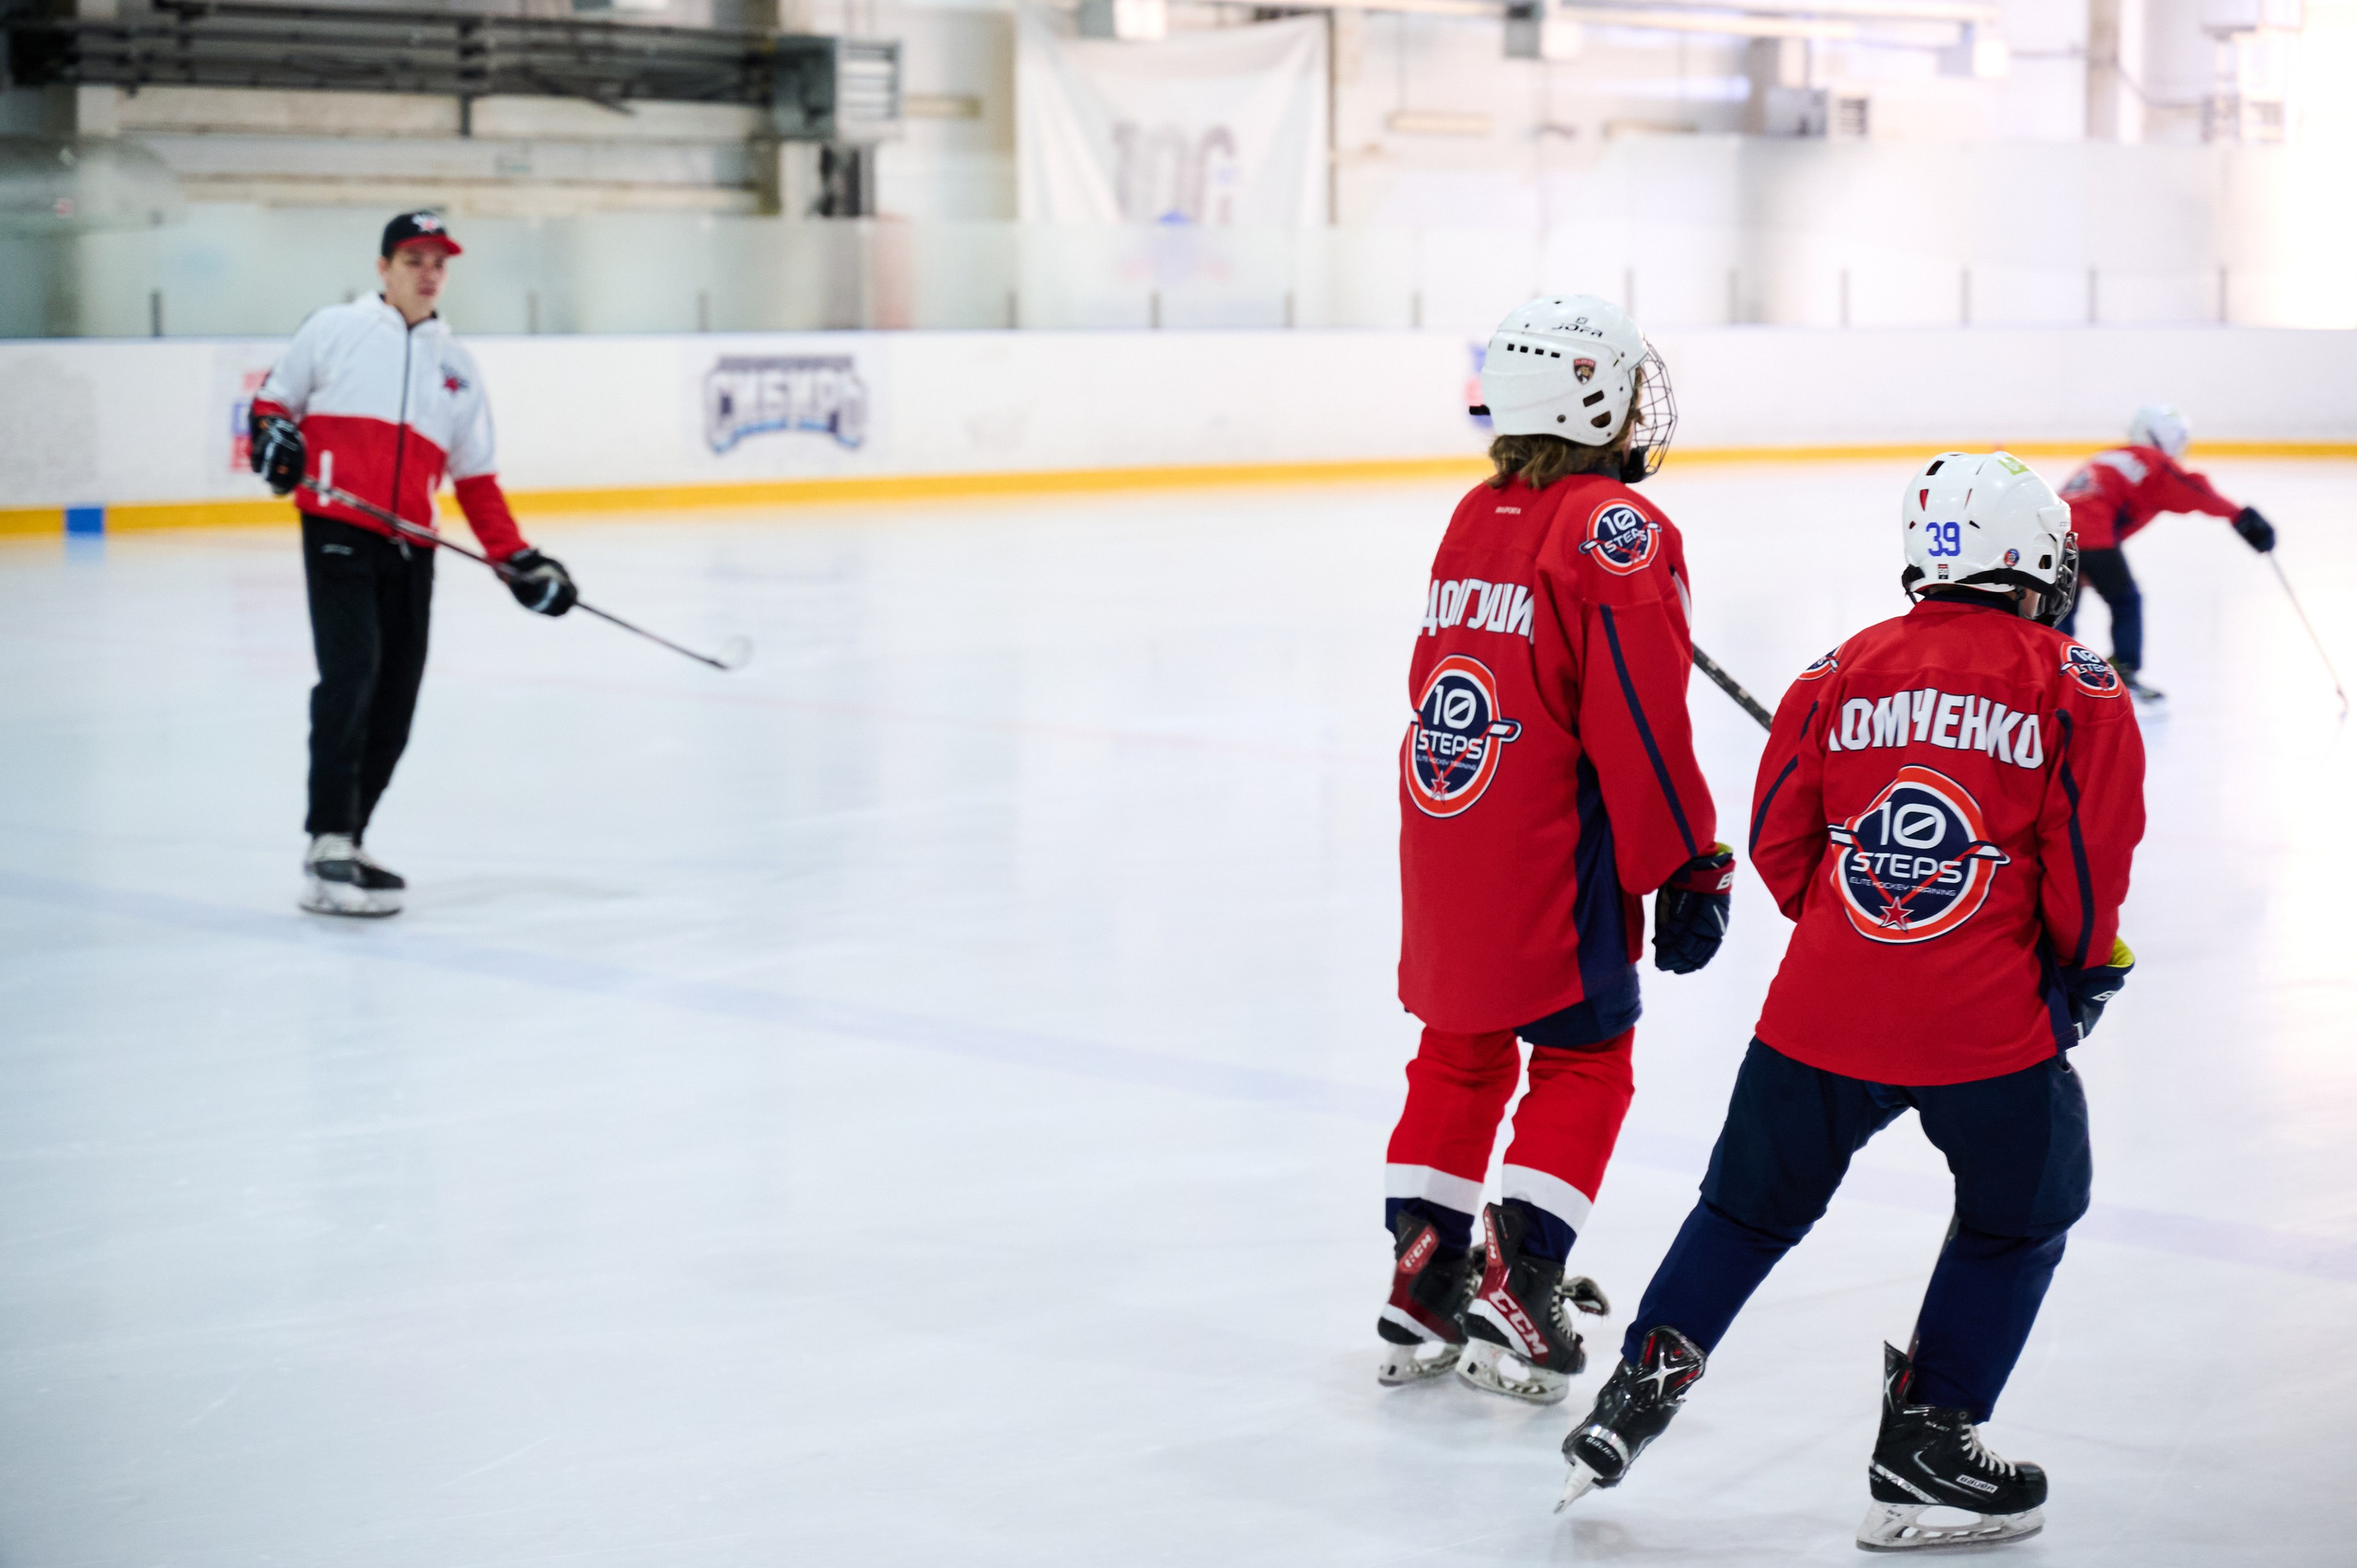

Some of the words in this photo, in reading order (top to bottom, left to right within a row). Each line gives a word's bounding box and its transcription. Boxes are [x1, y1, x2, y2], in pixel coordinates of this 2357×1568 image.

[1551, 322, 1603, 338] JOFA
[1602, 509, 1636, 536] 10
[1605, 528, 1647, 553] STEPS
[1925, 521, 1961, 557] 39
[1434, 684, 1477, 730] 10
[1416, 728, 1483, 760] STEPS
[1829, 687, 2044, 770] ОМЧЕНКО
[1879, 801, 1947, 849] 10
[1851, 852, 1963, 884] STEPS
[1850, 877, 1872, 887] ELITE
[1910, 885, 1956, 897] TRAINING
[1489, 1287, 1549, 1354] CCM
